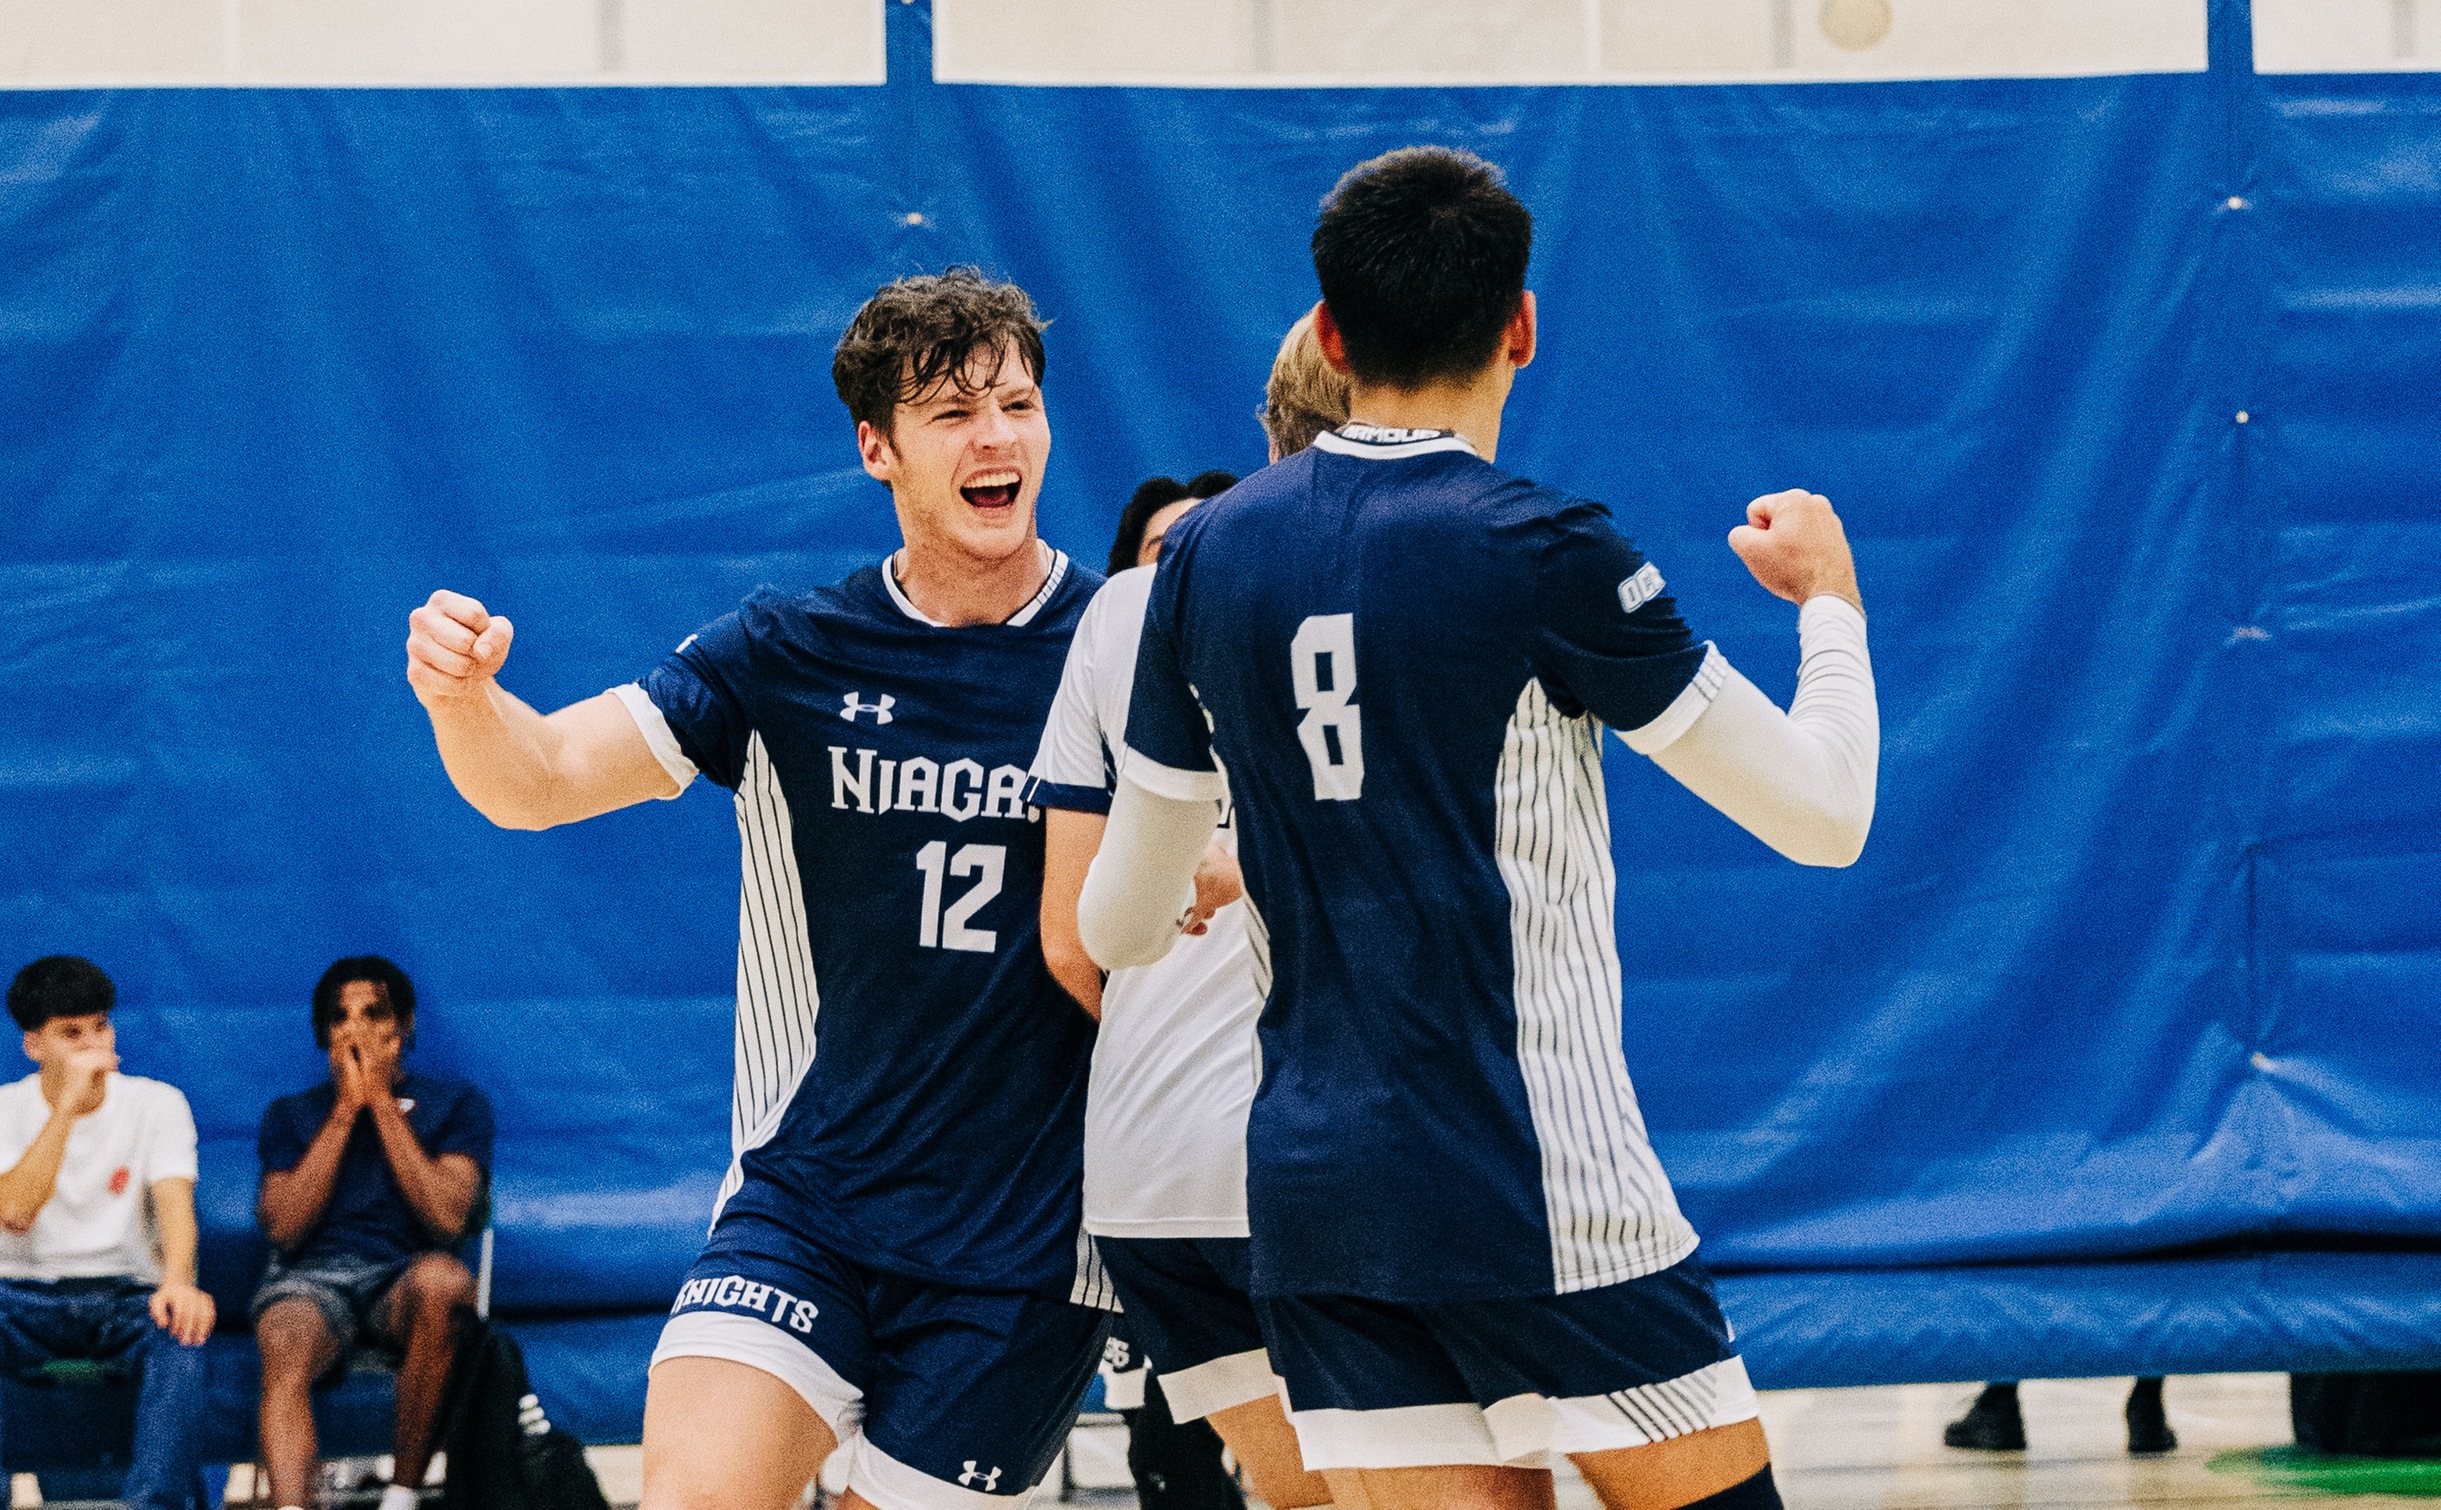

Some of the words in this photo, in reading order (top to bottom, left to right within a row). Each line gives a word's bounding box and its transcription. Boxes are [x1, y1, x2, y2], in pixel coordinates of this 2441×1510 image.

[1290, 612, 1365, 801] 8
[827, 745, 1041, 824] NIAGA
[916, 840, 1007, 953] 12
[669, 1274, 820, 1334] KNIGHTS
